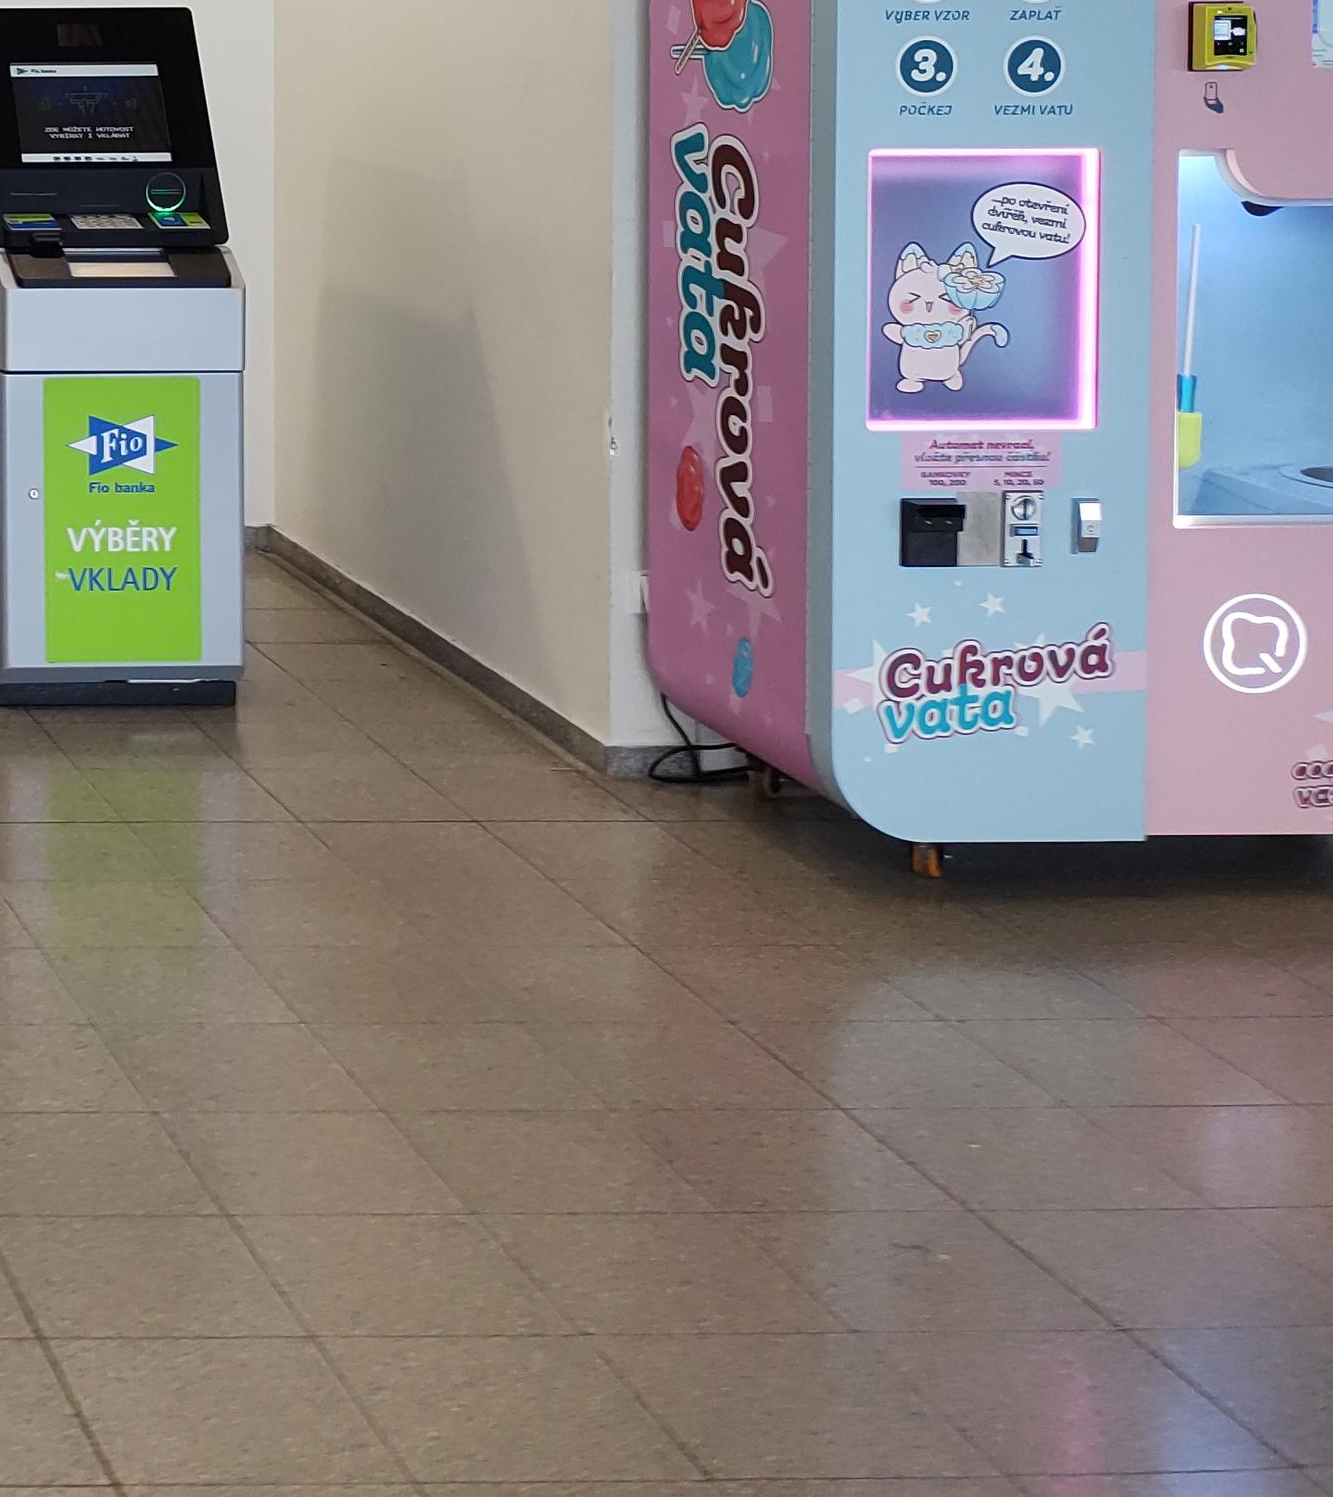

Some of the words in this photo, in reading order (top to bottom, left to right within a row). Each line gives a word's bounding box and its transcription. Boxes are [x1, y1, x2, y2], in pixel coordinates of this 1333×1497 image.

[934, 9, 970, 21] VZOR
[910, 48, 946, 82] 3.
[1017, 47, 1055, 82] 4.
[994, 103, 1035, 116] VEZMI
[1039, 103, 1073, 116] VATU
[1019, 199, 1069, 215] otevření
[982, 221, 1036, 238] cukrovou
[1031, 216, 1068, 229] vezmi
[674, 131, 725, 381] vata
[710, 144, 769, 588] Cukrová
[100, 428, 143, 464] Fio
[929, 439, 983, 449] Automat
[89, 482, 110, 493] Fio
[115, 482, 155, 493] banka
[67, 519, 177, 553] VÝBĚRY
[68, 567, 177, 592] VKLADY
[885, 624, 1110, 698] Cukrová
[884, 684, 1015, 740] vata
